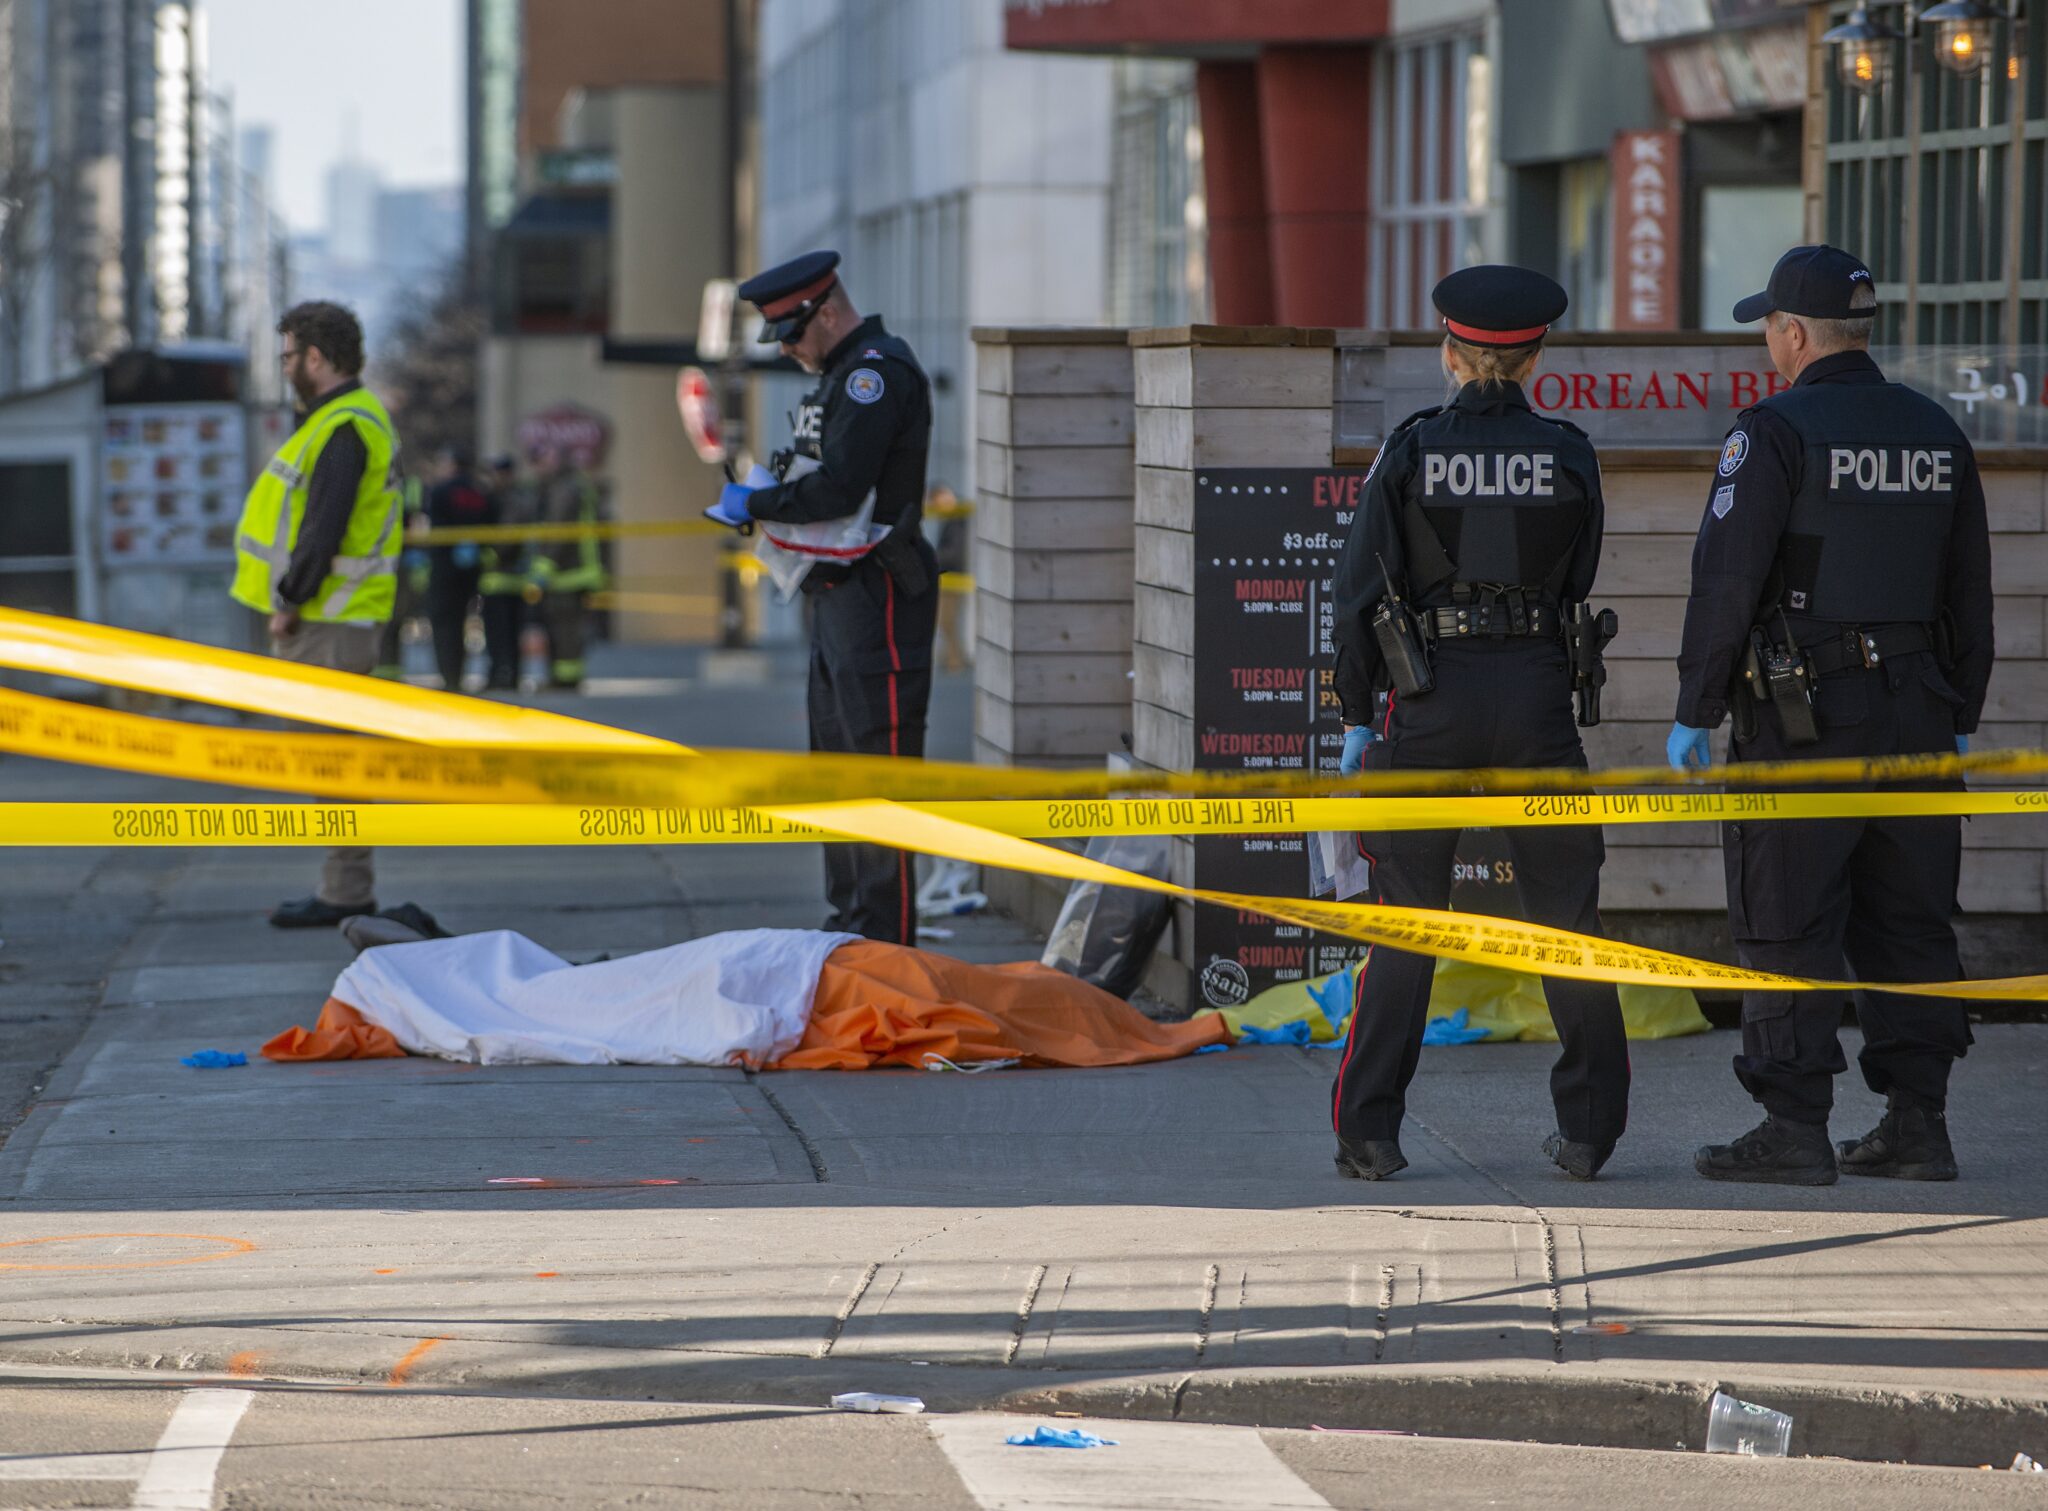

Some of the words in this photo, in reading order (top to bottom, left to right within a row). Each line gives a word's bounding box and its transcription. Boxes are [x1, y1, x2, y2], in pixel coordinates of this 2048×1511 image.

[1630, 136, 1666, 323] KARAOKE
[1533, 370, 1712, 411] OREAN
[1948, 367, 2029, 414] 구이
[1425, 453, 1554, 496] POLICE
[1830, 448, 1953, 492] POLICE
[1313, 476, 1366, 507] EVE
[1283, 533, 1302, 550] $3
[1305, 533, 1329, 549] off
[1235, 579, 1306, 600] MONDAY
[1243, 602, 1273, 613] 5:00PM
[1280, 602, 1304, 613] CLOSE
[1231, 668, 1306, 689] TUESDAY
[1243, 691, 1273, 701] 5:00PM
[1280, 691, 1304, 701] CLOSE
[1201, 734, 1306, 754] WEDNESDAY
[1243, 757, 1273, 767] 5:00PM
[1280, 757, 1304, 767] CLOSE
[1243, 840, 1273, 851] 5:00PM
[1280, 840, 1304, 851] CLOSE
[1275, 926, 1303, 938] ALLDAY
[1237, 946, 1306, 967] SUNDAY
[1555, 948, 1582, 966] POLICE
[1201, 967, 1249, 1001] ssam
[1275, 969, 1303, 980] ALLDAY
